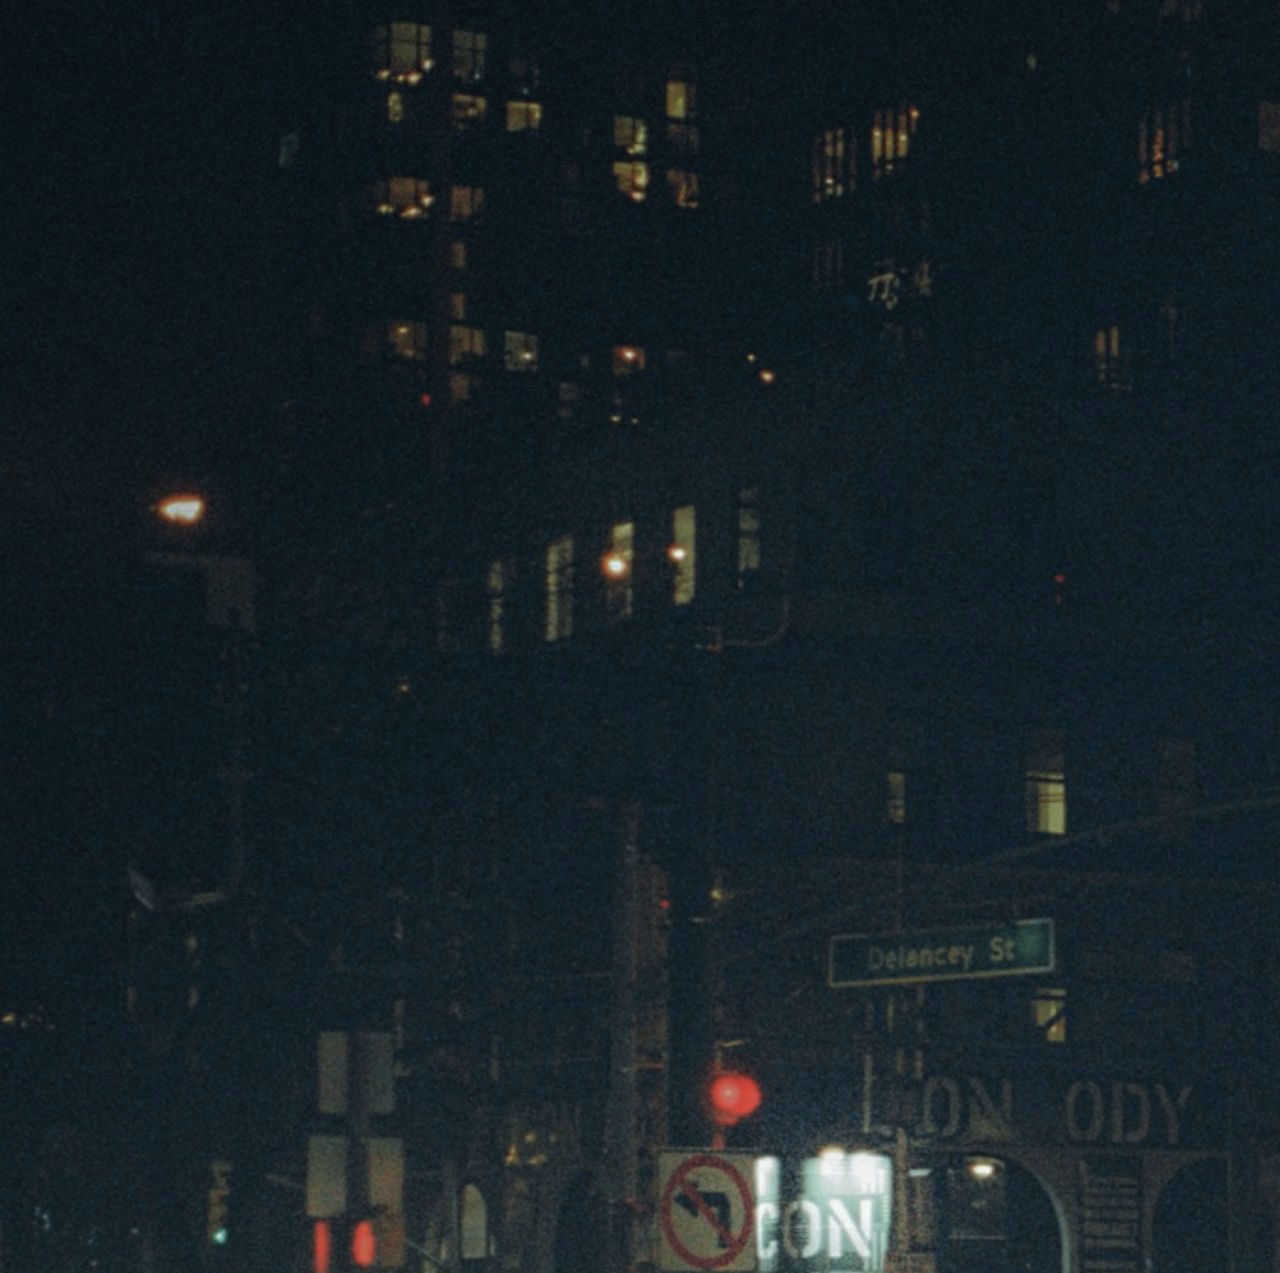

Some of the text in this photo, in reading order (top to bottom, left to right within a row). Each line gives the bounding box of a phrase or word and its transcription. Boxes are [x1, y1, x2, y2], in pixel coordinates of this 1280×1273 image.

[867, 935, 1015, 972] Delancey St
[755, 1198, 873, 1259] CON
